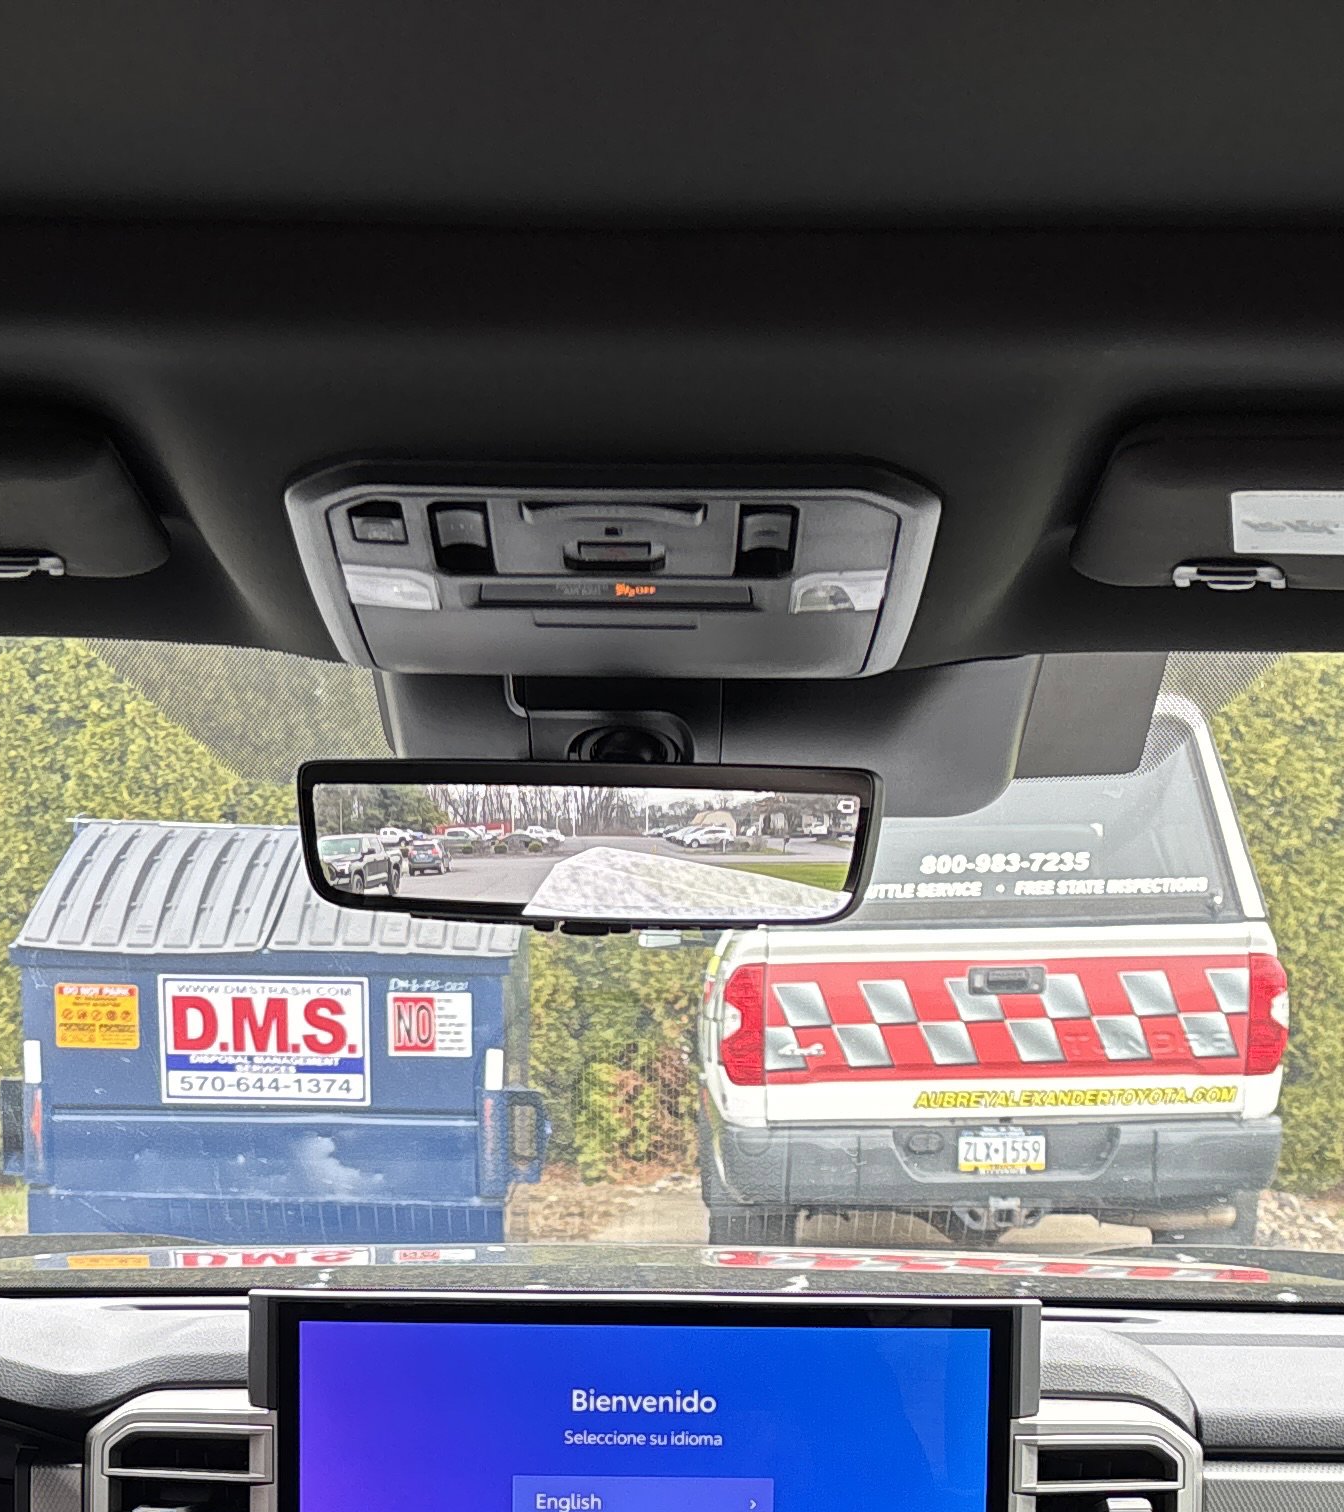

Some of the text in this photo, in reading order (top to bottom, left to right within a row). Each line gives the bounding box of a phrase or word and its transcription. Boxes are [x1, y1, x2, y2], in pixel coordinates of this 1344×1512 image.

[919, 852, 1091, 874] 800-983-7235
[864, 877, 1209, 899] UTTLE SERVICE FREE STATE INSPECTIONS
[172, 995, 358, 1055] D.M.S.
[395, 1003, 434, 1046] NO
[180, 1076, 353, 1094] 570-644-1374
[914, 1086, 1238, 1109] AUBREYALEXANDERTOYOTA.COM
[570, 1388, 718, 1414] Bienvenido
[564, 1430, 724, 1447] Seleccione su idioma
